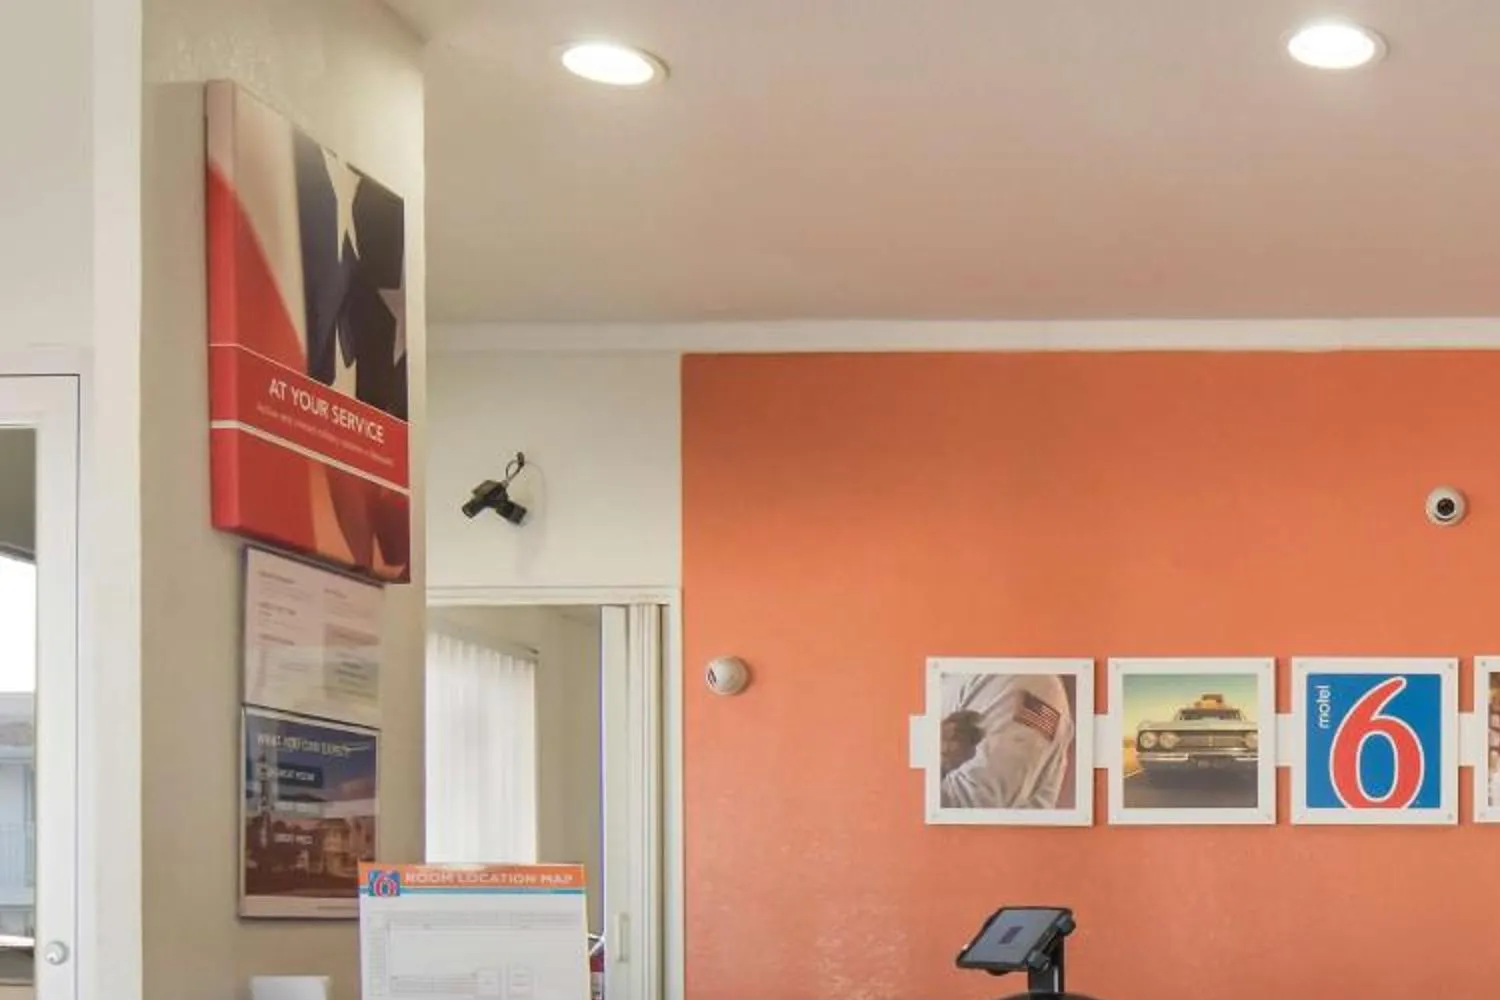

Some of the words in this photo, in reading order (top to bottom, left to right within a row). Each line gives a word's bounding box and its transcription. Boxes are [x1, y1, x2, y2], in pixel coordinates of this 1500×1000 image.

[269, 378, 287, 401] AT
[291, 388, 330, 420] YOUR
[331, 405, 386, 444] SERVICE
[1315, 685, 1331, 729] motel
[1329, 676, 1426, 810] 6
[404, 871, 450, 885] ROOM
[457, 872, 537, 885] LOCATION
[540, 874, 575, 886] MAP
